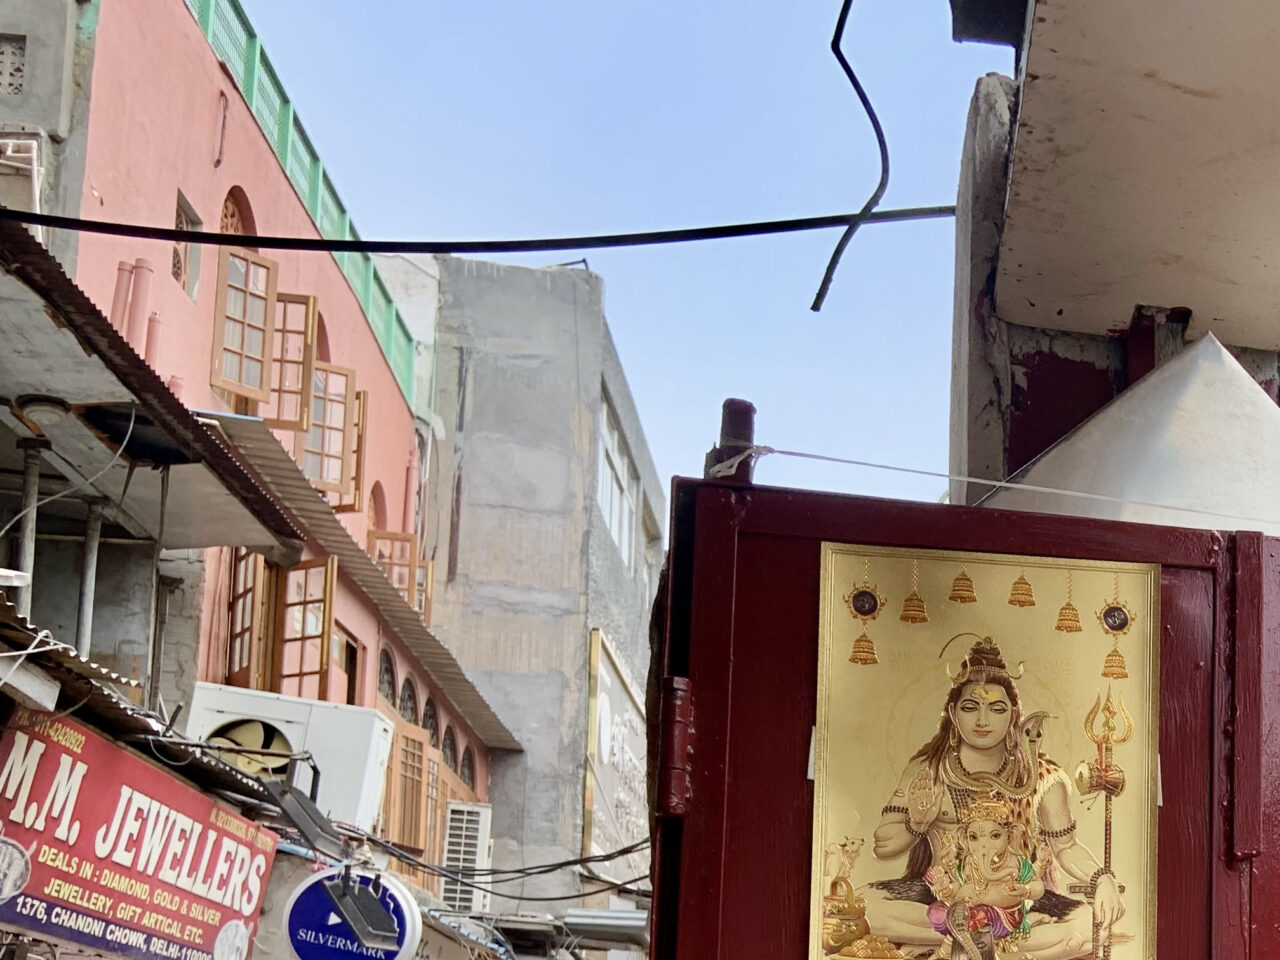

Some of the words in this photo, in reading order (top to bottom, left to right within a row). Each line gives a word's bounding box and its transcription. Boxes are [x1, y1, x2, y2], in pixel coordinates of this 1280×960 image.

[0, 730, 88, 846] M.M.
[94, 784, 266, 917] JEWELLERS
[38, 845, 79, 877] DEALS
[79, 860, 94, 881] IN
[100, 870, 150, 905] DIAMOND,
[153, 889, 181, 910] GOLD
[180, 899, 189, 915] &
[190, 902, 222, 927] SILVER
[44, 877, 114, 919] JEWELLERY,
[116, 902, 142, 924] GIFT
[141, 911, 183, 938] ARTICAL
[183, 926, 205, 945] ETC.
[15, 895, 48, 924] 1376,
[51, 907, 106, 936] CHANDNI
[106, 923, 148, 953] CHOWK,
[297, 928, 386, 960] SILVERMARK
